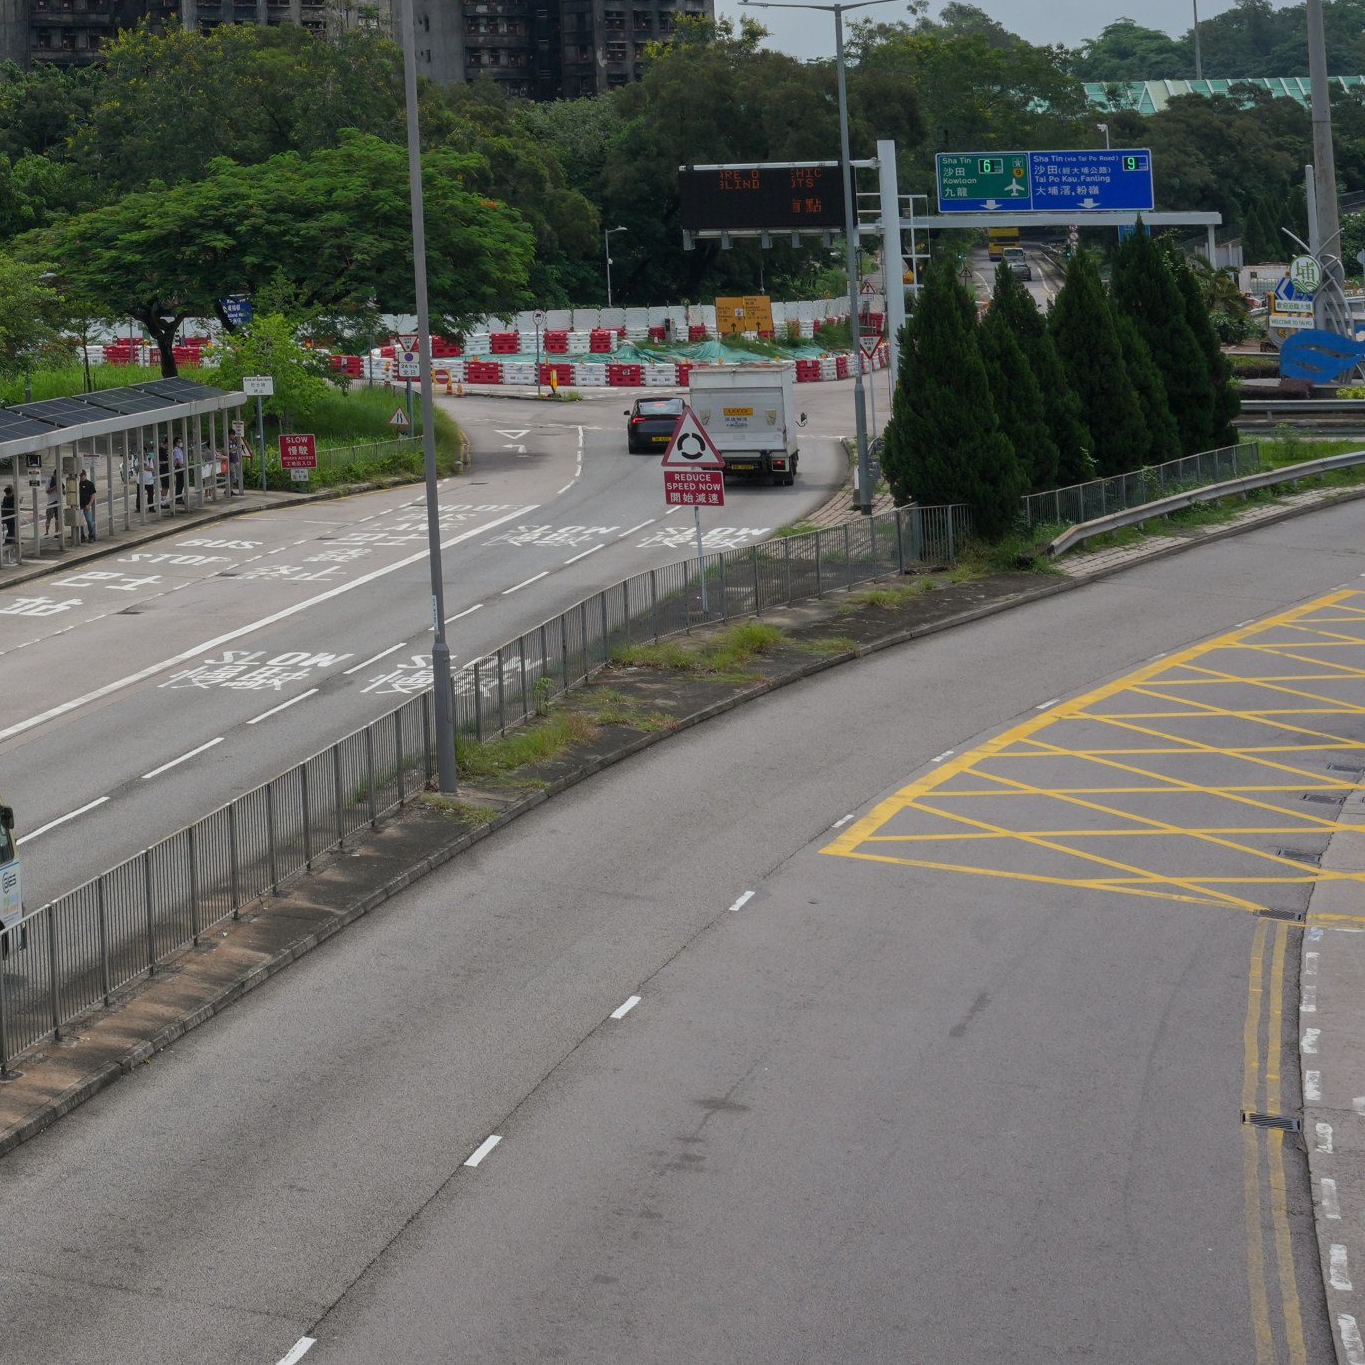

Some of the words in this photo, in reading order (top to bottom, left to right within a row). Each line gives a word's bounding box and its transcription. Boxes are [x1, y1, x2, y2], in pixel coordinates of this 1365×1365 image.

[983, 160, 991, 172] 6
[1128, 157, 1136, 170] 9
[943, 167, 965, 176] 沙田
[945, 187, 968, 197] 九龍
[674, 473, 711, 482] REDUCE
[667, 482, 696, 491] SPEED
[699, 483, 721, 491] NOW
[670, 492, 719, 504] 開始減速
[176, 538, 265, 550] BUS
[117, 553, 232, 566] STOP
[50, 571, 163, 591] 巴士
[204, 650, 354, 668] SLOW
[157, 666, 311, 691] 慢駛
